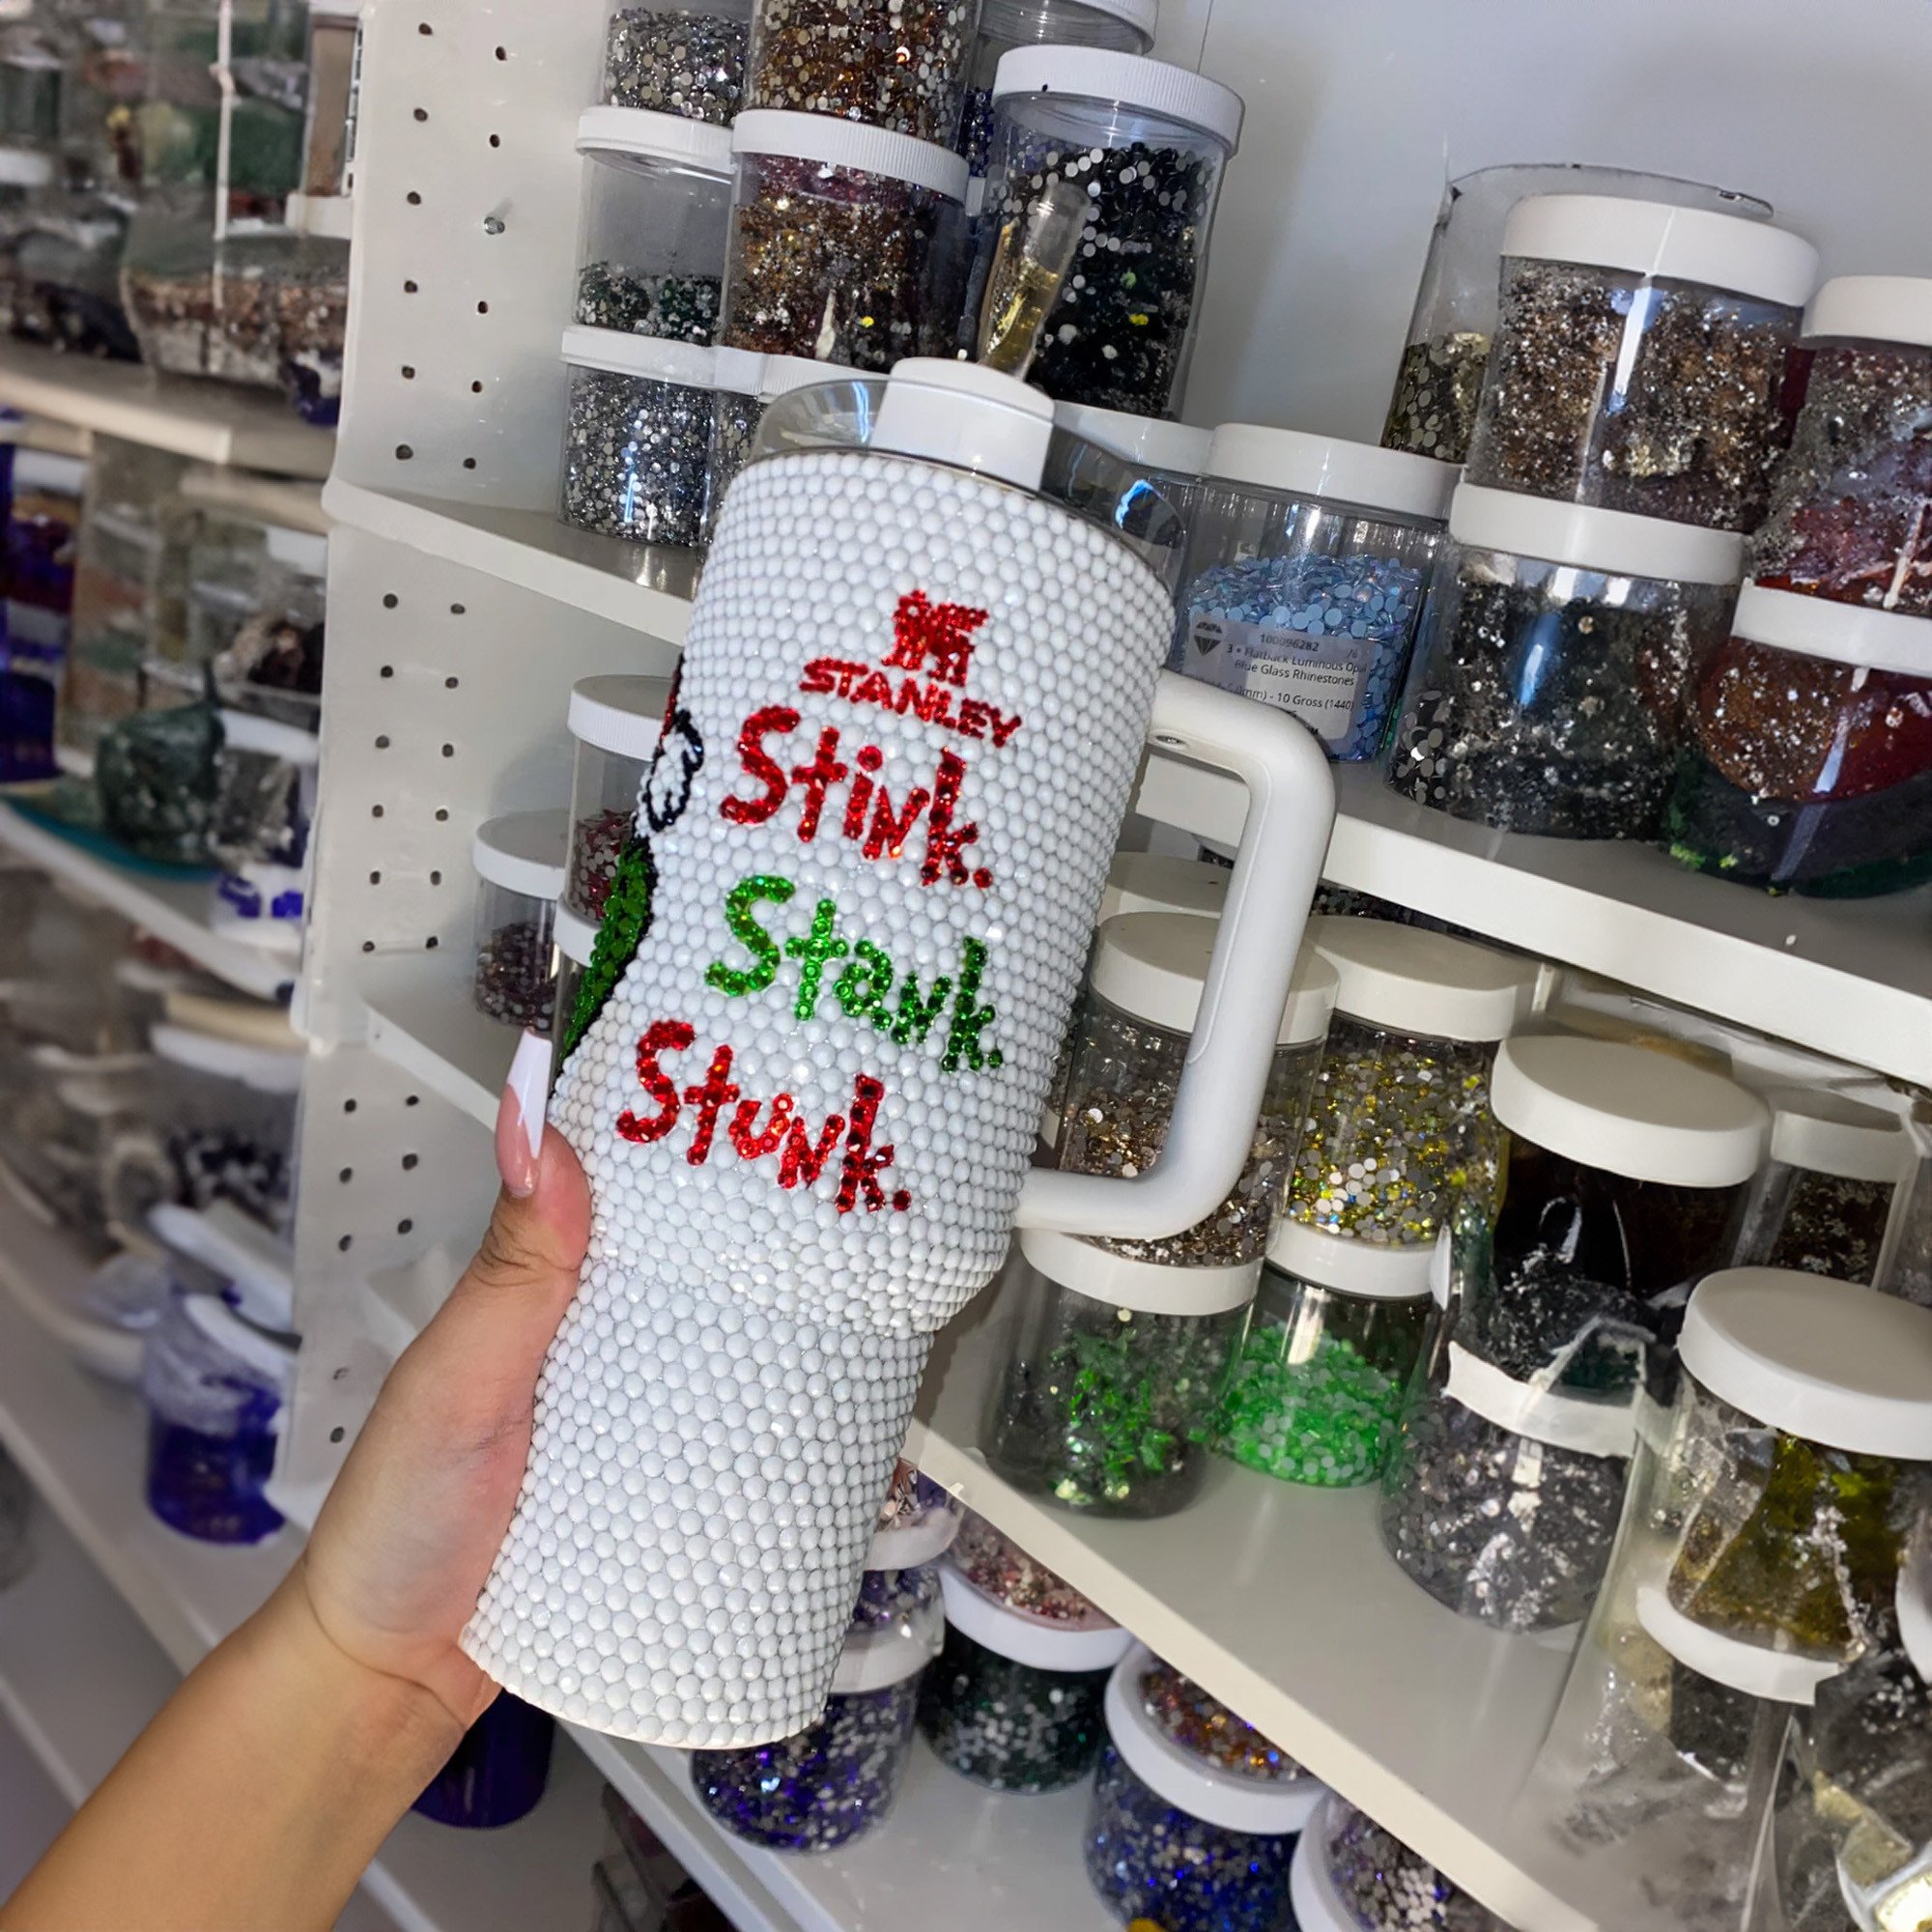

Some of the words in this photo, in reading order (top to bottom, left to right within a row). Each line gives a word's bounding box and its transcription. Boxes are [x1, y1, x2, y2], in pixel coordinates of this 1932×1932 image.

[1235, 659, 1258, 672] Blue
[1261, 664, 1291, 678] Glass
[1293, 668, 1354, 686] Rhinestones
[1292, 656, 1344, 671] Luminous
[799, 657, 1022, 748] STANLEY
[1277, 692, 1291, 704] 10
[1293, 695, 1323, 708] Gross
[720, 704, 994, 888] Stink.
[616, 1019, 912, 1213] Stunk.
